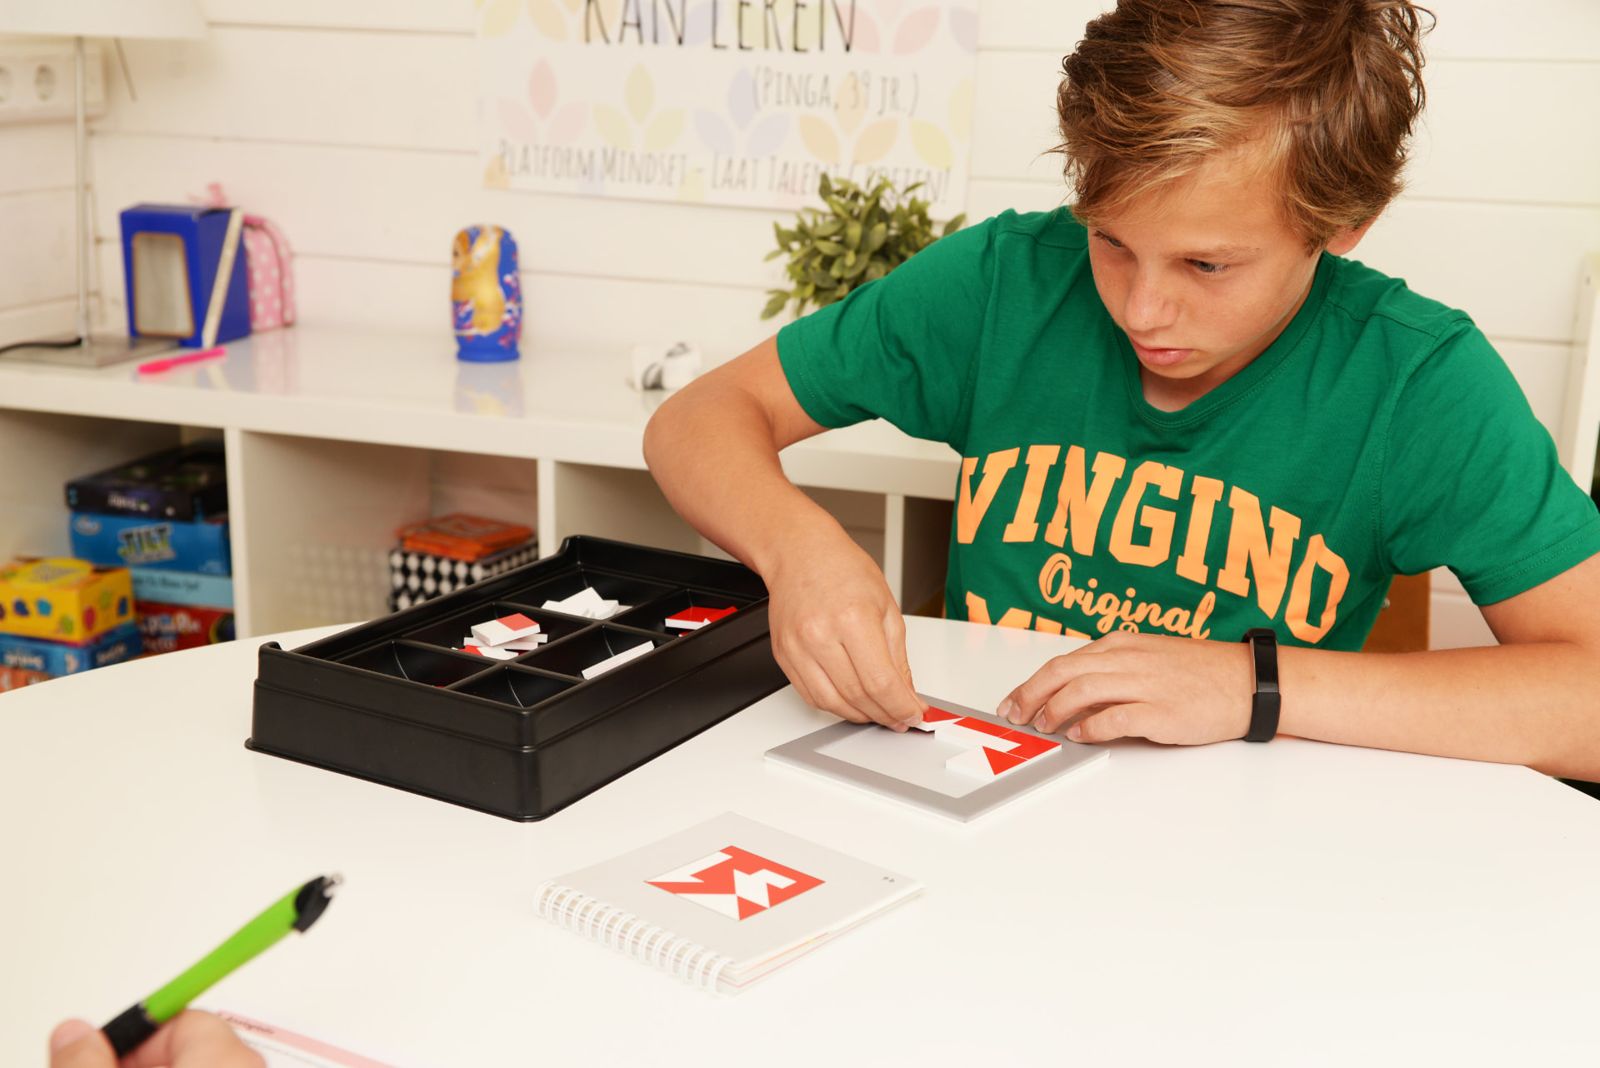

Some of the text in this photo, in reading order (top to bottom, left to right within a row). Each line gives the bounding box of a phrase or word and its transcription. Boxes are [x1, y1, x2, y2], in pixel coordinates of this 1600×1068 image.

[711, 0, 856, 53] LEREN
[601, 145, 688, 188] MINDSET
[711, 151, 760, 191] LAAT
[956, 444, 1350, 644] VINGINO
[1038, 552, 1216, 640] Original
